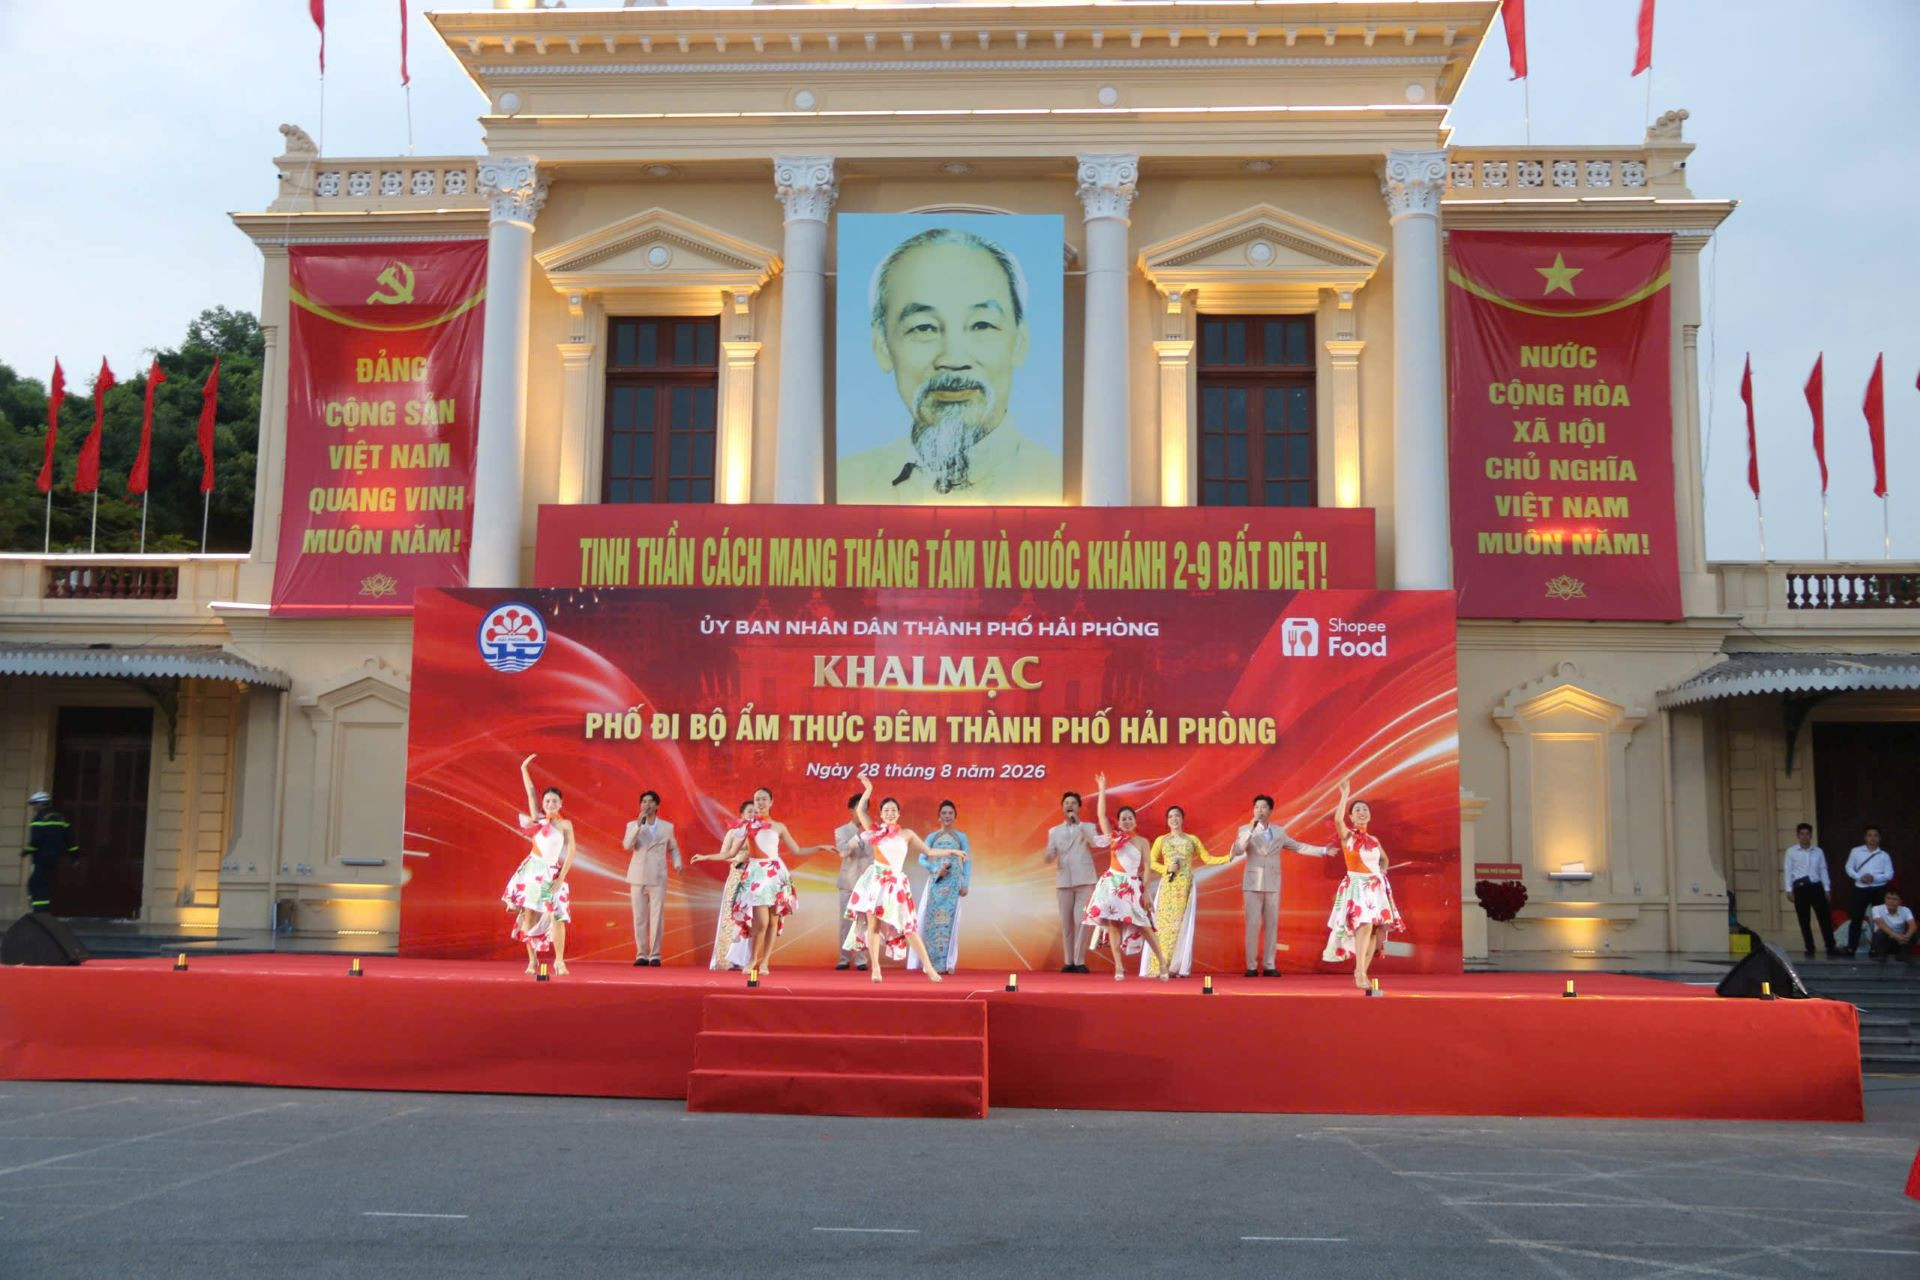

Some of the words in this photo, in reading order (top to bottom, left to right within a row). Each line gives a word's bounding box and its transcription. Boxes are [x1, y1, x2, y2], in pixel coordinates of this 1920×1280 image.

[356, 349, 428, 383] ĐẢNG
[1520, 343, 1597, 369] NƯỚC
[1488, 379, 1564, 410] CỘNG
[1574, 380, 1630, 407] HÒA
[325, 396, 395, 431] CỘNG
[404, 391, 455, 425] SẢN
[1512, 417, 1549, 444] XÃ
[1559, 417, 1606, 449] HỘI
[329, 440, 383, 475] VIỆT
[390, 443, 450, 469] NAM
[1485, 451, 1540, 481] CHỦ
[1549, 455, 1637, 482] NGHĨA
[308, 486, 396, 514] QUANG
[404, 485, 464, 511] VINH
[1494, 491, 1553, 522] VIỆT
[1562, 495, 1629, 518] NAM
[302, 524, 382, 555] MUÔN
[390, 523, 460, 554] NĂM!
[1478, 528, 1562, 555] MUÔN
[1572, 528, 1650, 555] NĂM!
[580, 537, 630, 586] TINH
[637, 521, 695, 586] THẦN
[702, 527, 761, 587] CÁCH
[844, 528, 919, 588] THÁNG
[926, 529, 975, 589] TÁM
[982, 529, 1012, 589] VÀ
[1087, 529, 1166, 590] KHÁNH
[1173, 540, 1211, 590] 2-9
[1218, 523, 1261, 590] BẤT
[700, 614, 730, 635] ỦY
[735, 620, 780, 635] BAN
[785, 617, 848, 636] NHÂN
[853, 617, 898, 636] DÂN
[903, 615, 981, 637] THÀNH
[987, 614, 1033, 637] PHỐ
[1038, 616, 1076, 637] HẢI
[1081, 617, 1159, 637] PHÒNG
[1328, 618, 1387, 635] Shopee
[1328, 635, 1387, 657] Food
[813, 655, 925, 690] KHAI
[937, 655, 1044, 698] MẠC
[585, 703, 645, 740] PHỐ
[651, 712, 680, 740] ĐI
[689, 707, 727, 747] BỘ
[735, 702, 780, 741] ẨM
[788, 711, 864, 748] THỰC
[873, 709, 937, 743] ĐÊM
[946, 709, 1041, 744] THÀNH
[1051, 706, 1113, 744] PHỐ
[1120, 709, 1168, 744] HẢI
[1178, 711, 1277, 745] PHÒNG
[806, 763, 853, 780] Ngày
[858, 763, 880, 777] 28
[885, 763, 936, 779] tháng
[941, 764, 952, 777] 8
[956, 764, 995, 778] năm
[1000, 764, 1046, 779] 2026
